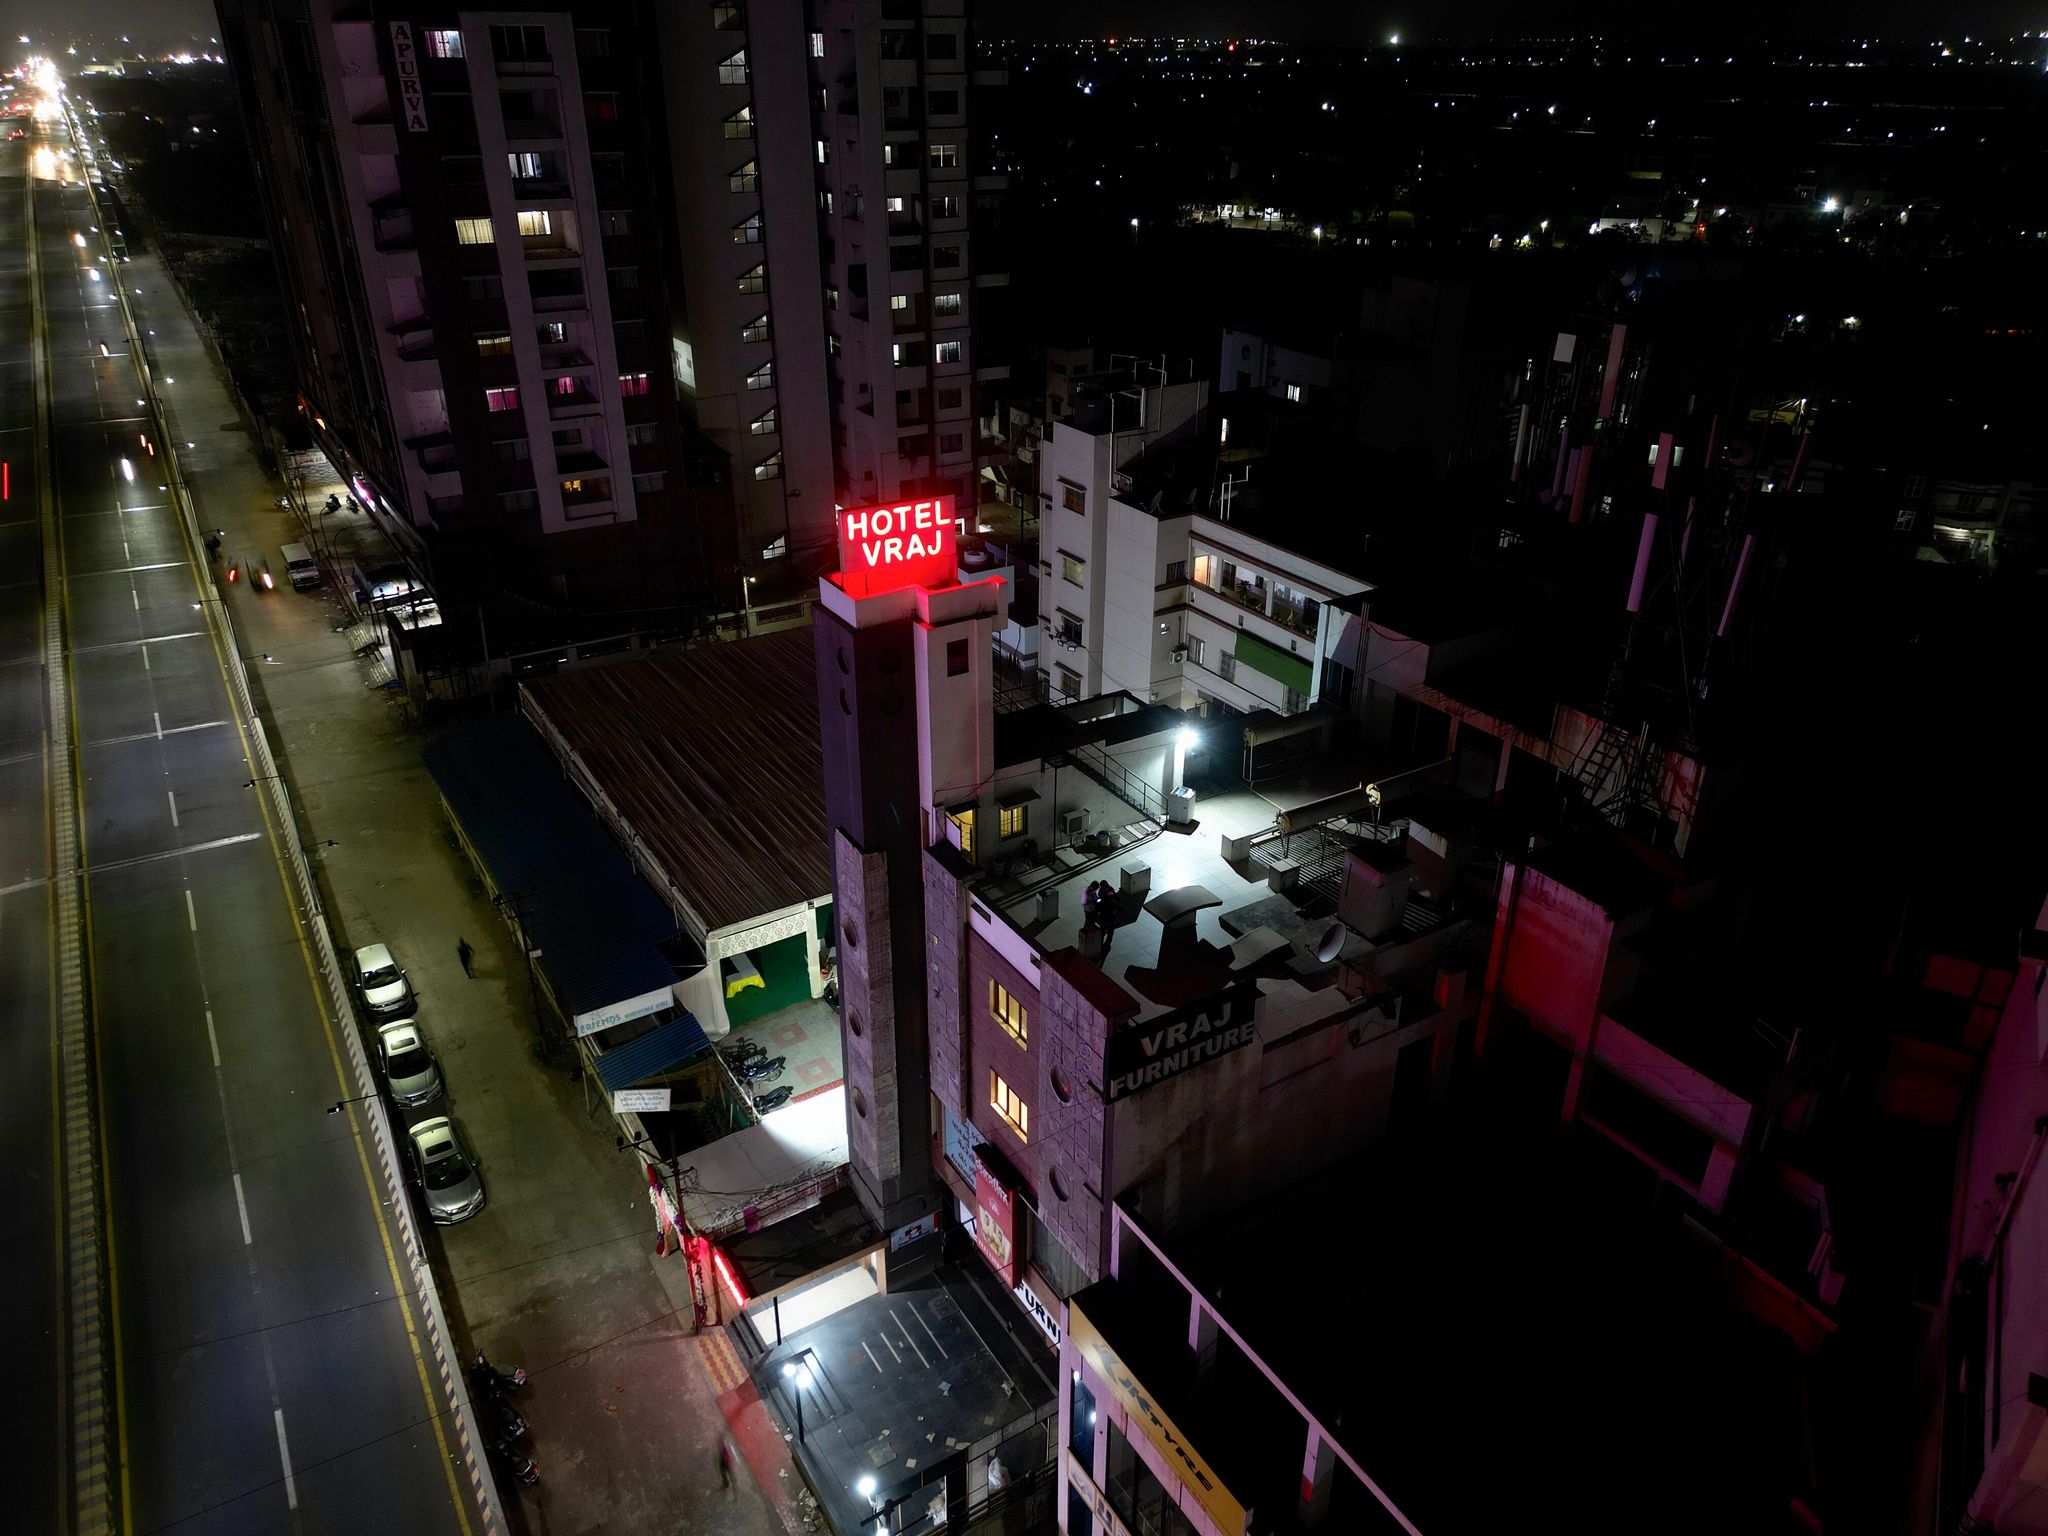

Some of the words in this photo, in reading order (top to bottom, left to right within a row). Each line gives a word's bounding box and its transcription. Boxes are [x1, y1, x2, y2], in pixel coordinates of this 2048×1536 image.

[394, 24, 426, 129] APURVA
[847, 500, 951, 541] HOTEL
[862, 530, 943, 567] VRAJ
[1139, 1001, 1232, 1057] VRAJ
[1110, 1021, 1255, 1099] FURNITURE
